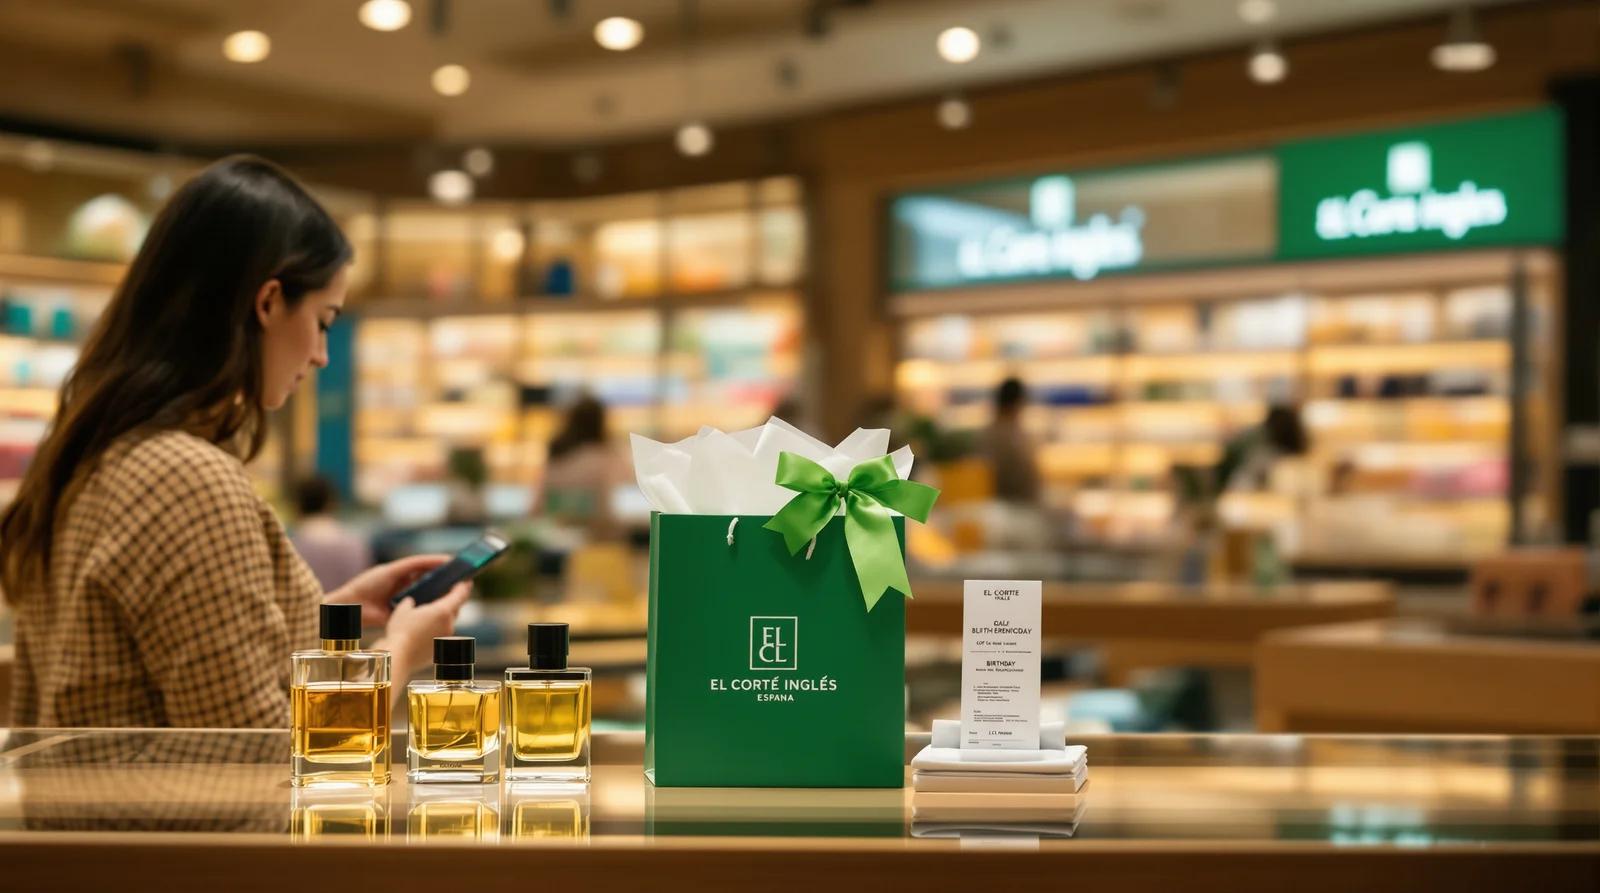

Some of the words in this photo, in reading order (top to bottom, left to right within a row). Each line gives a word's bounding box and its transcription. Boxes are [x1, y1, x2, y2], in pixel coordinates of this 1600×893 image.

[710, 679, 727, 690] EL
[731, 676, 779, 691] CORTÉ
[784, 675, 837, 691] INGLÉS
[757, 694, 794, 702] ESPANA
